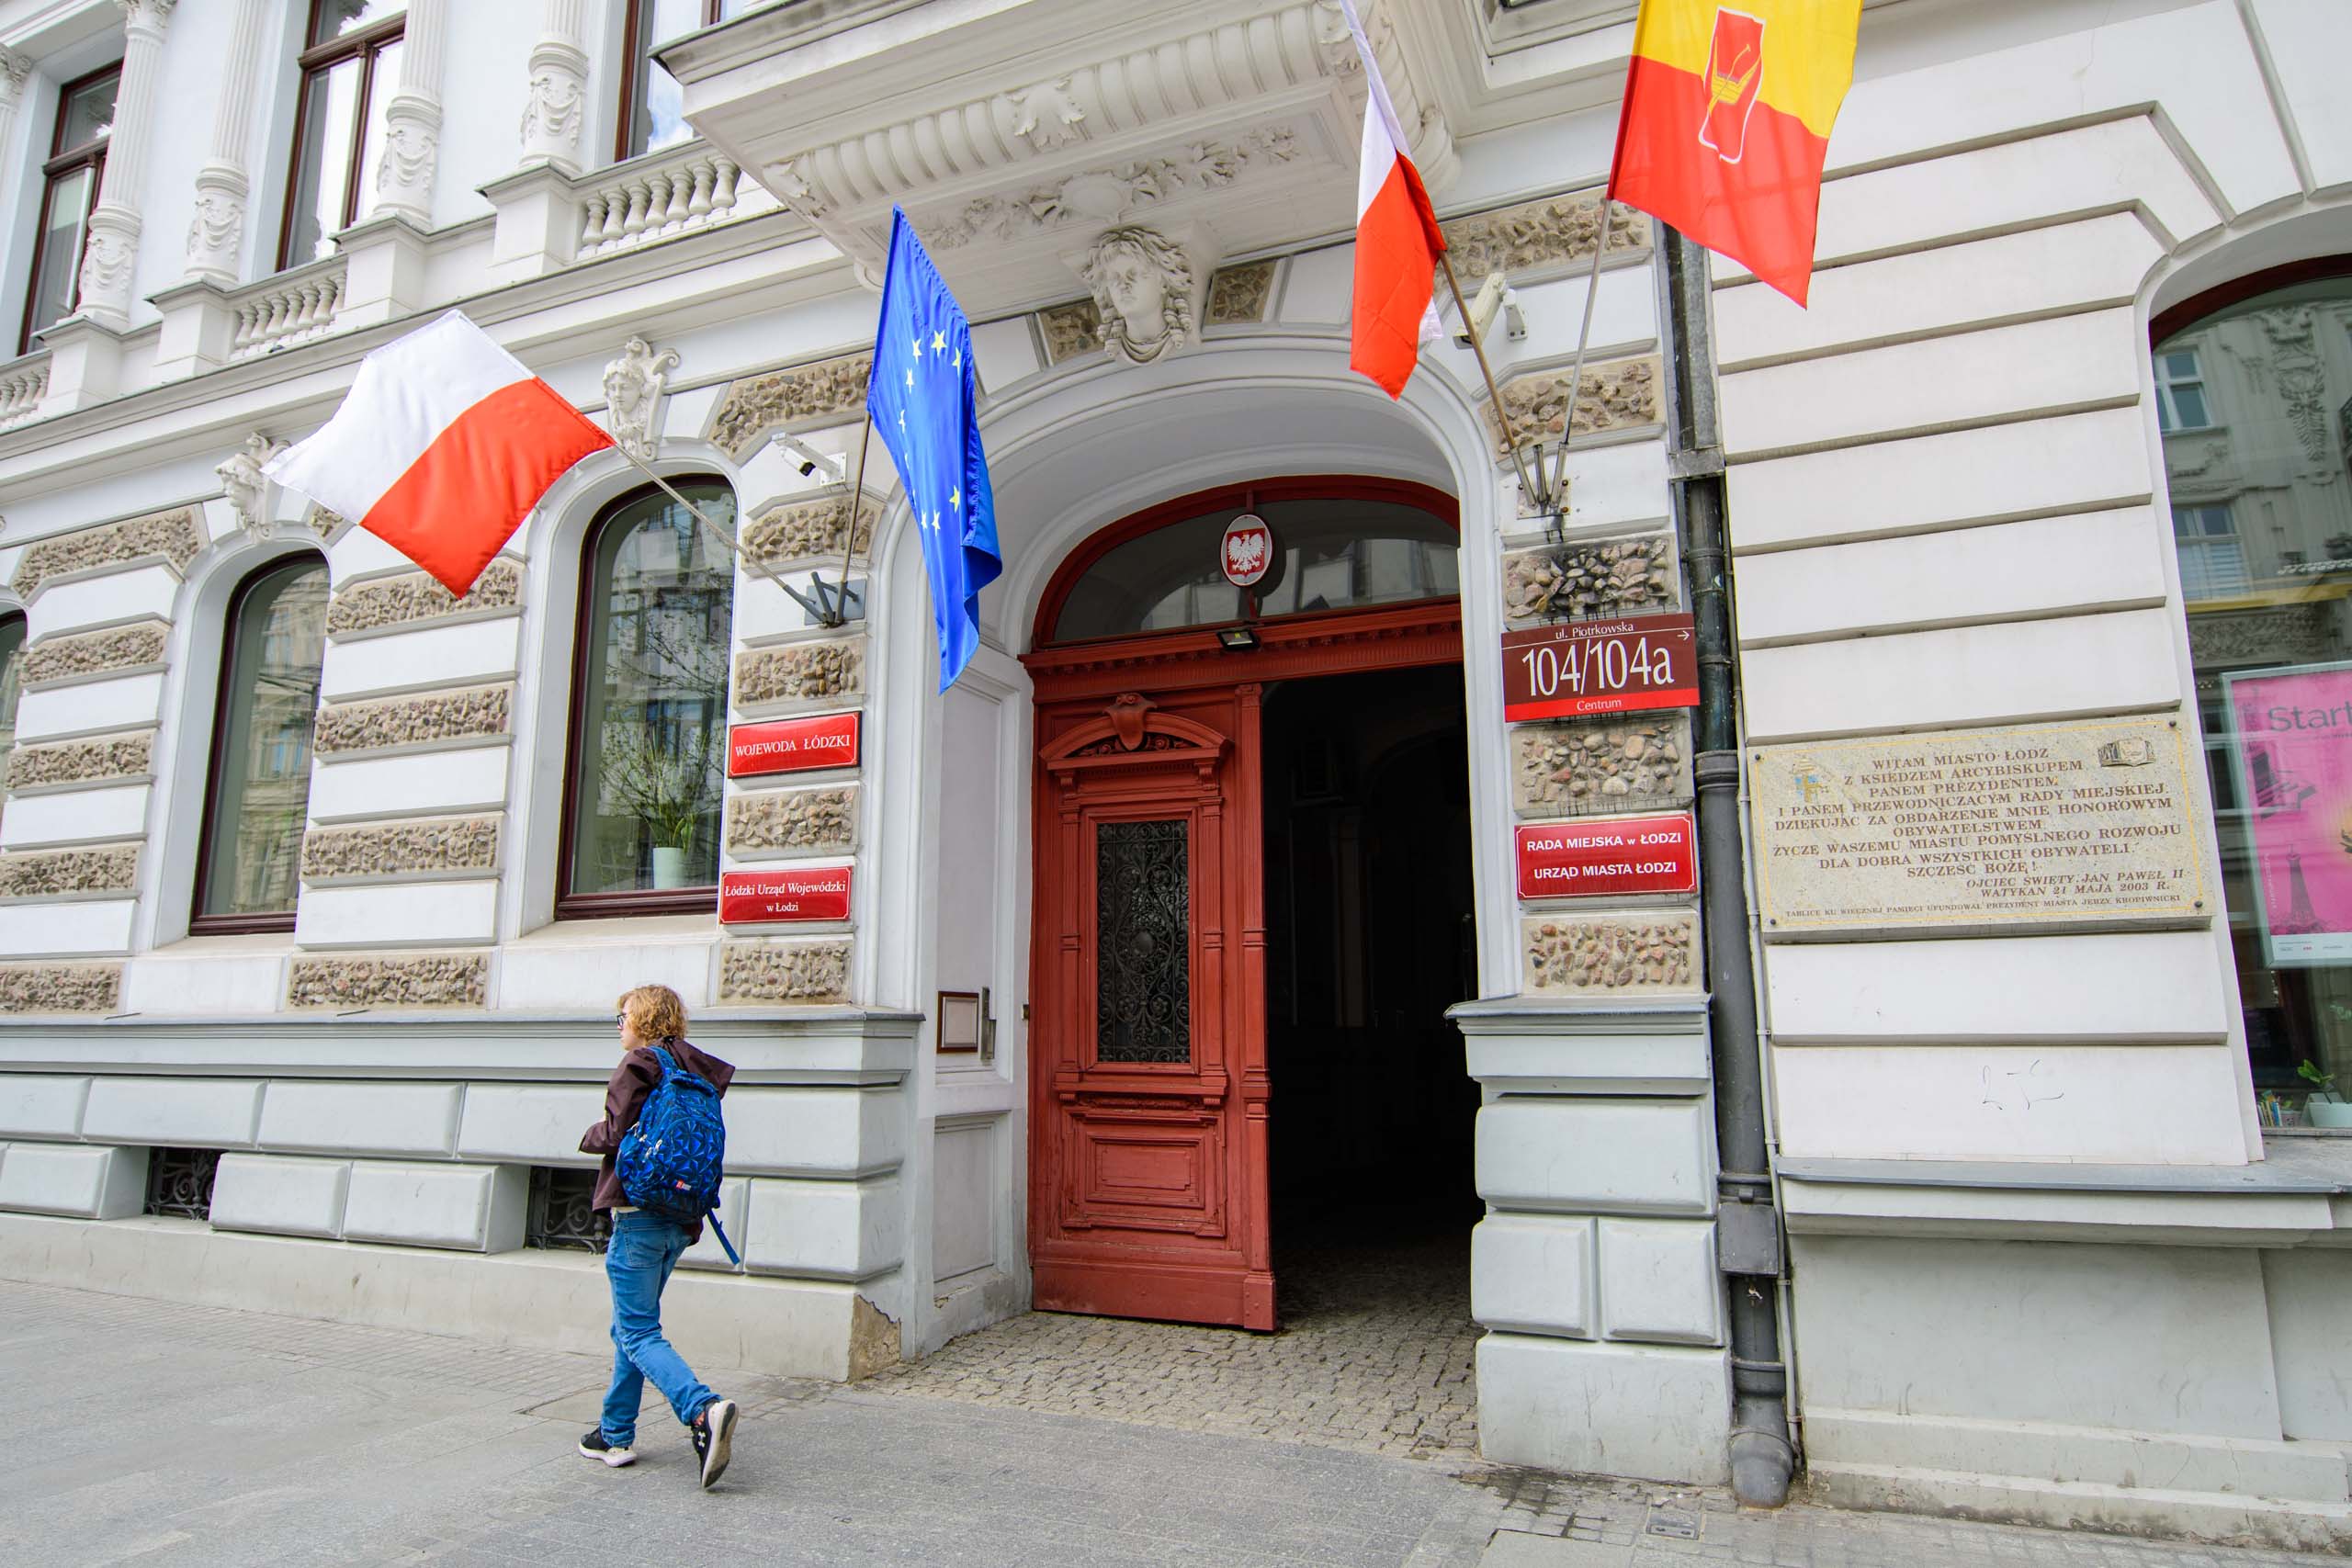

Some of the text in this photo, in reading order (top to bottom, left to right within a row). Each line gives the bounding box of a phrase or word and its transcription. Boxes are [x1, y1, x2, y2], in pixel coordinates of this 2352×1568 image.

[1555, 622, 1634, 640] ul. Piotrkowska
[1521, 637, 1675, 697] 104/104a
[1577, 699, 1622, 711] Centrum
[735, 735, 850, 757] WOJEWODA ŁÓDZKI
[1872, 757, 1926, 770] WITAM
[1934, 752, 1996, 765] MIASTO
[1844, 776, 1853, 785] Z
[1951, 761, 2083, 779] ARCYBISKUPEM
[1870, 776, 2058, 797] PANEM PREZYDENTEM
[1779, 807, 1783, 817] I
[1792, 804, 1844, 816] PANEM
[2019, 790, 2064, 802] RADY
[1868, 816, 1887, 825] ZA
[1894, 808, 1998, 823] OBDARZENIE
[2007, 806, 2050, 817] MNIE
[1894, 819, 2041, 837] OBYWATELSTWEM
[1527, 840, 1563, 852] RADA
[1566, 836, 1623, 849] MIEJSKA
[1640, 832, 1681, 844] ŁODZI
[1826, 840, 1901, 853] WASZEMU
[1909, 837, 1970, 850] MIASTU
[2098, 824, 2181, 839] ROZWOJU
[1820, 858, 1850, 869] DLA
[1858, 855, 1911, 867] DOBRA
[1919, 850, 2021, 863] WSZYSTKICH
[1534, 862, 1677, 880] URZĄD MIASTA ŁODZI
[1966, 877, 2017, 888] OJCIEC
[2172, 869, 2184, 878] II
[725, 881, 846, 897] Łódzki Urząd Wojewódzki
[1981, 886, 2046, 897] WATYKAN
[2075, 884, 2112, 894] MAJA
[2120, 883, 2149, 891] 2003
[775, 901, 799, 911] Łodzi
